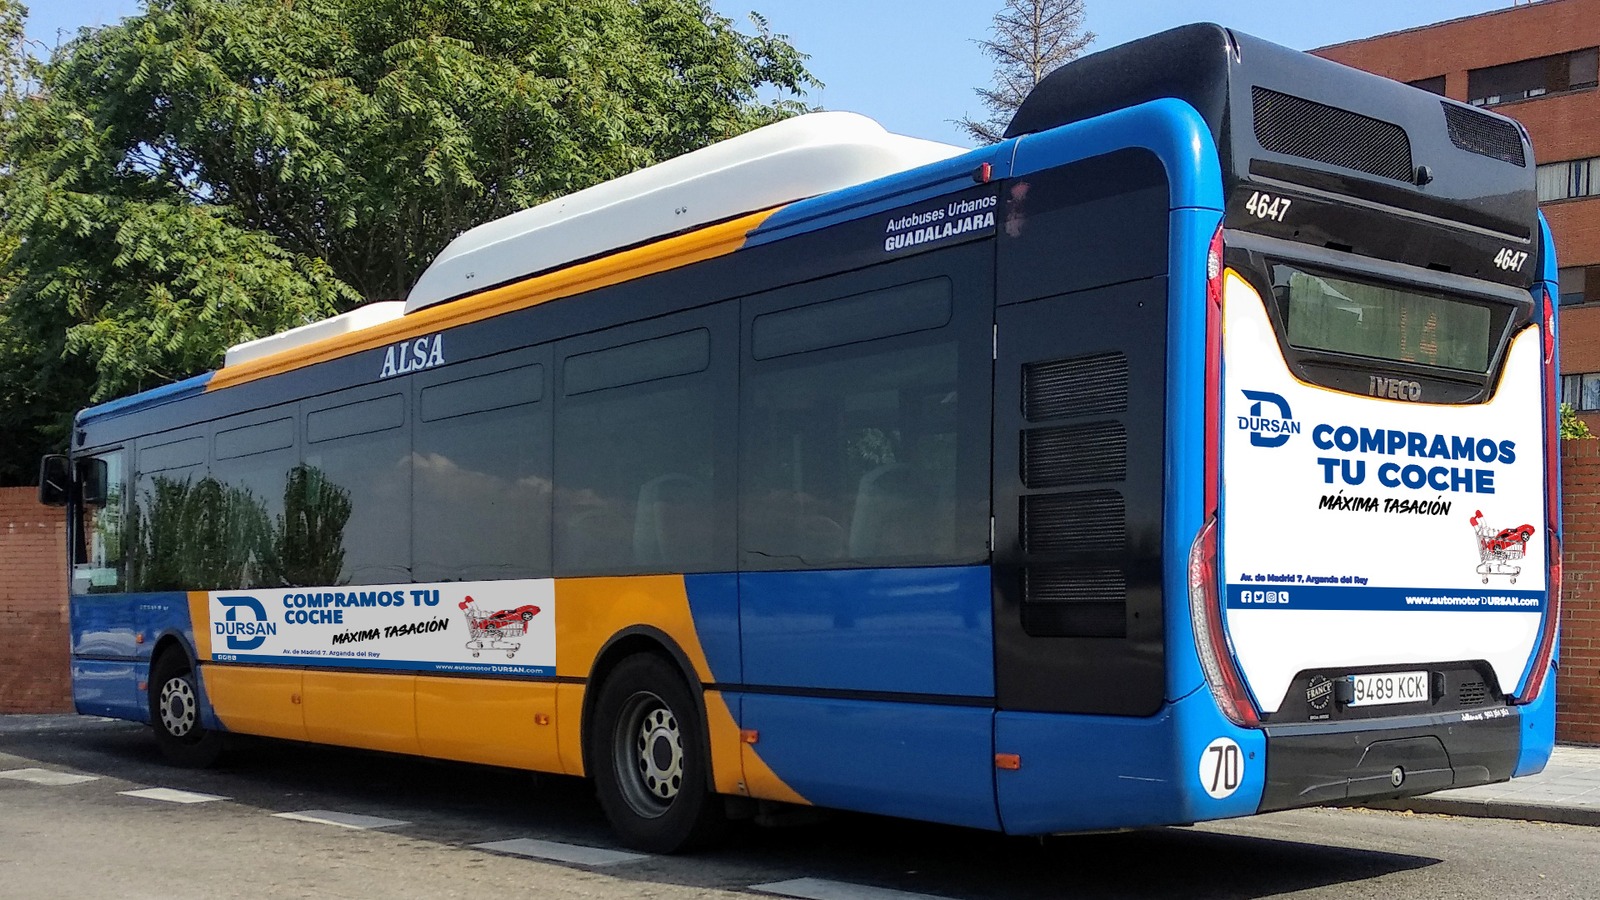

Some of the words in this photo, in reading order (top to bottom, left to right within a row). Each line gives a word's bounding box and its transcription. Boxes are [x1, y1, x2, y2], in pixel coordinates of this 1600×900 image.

[886, 209, 945, 233] Autobuses
[948, 195, 997, 217] Urbanos
[1245, 191, 1291, 222] 4647
[885, 211, 995, 252] GUADALAJARA
[1494, 247, 1528, 273] 4647
[380, 334, 445, 378] ALSA
[1369, 376, 1422, 401] IVECO
[1237, 416, 1301, 435] DURSAN
[1312, 423, 1516, 465] COMPRAMOS
[1317, 457, 1366, 486] TU
[1377, 462, 1495, 494] COCHE
[1319, 490, 1379, 513] MÁXIMA
[1384, 496, 1452, 516] TASACIÓN
[1255, 573, 1266, 582] de
[1267, 574, 1296, 583] Madrid
[1305, 575, 1339, 584] Arganda
[1340, 575, 1352, 584] del
[1353, 576, 1368, 585] Rey
[283, 591, 405, 608] COMPRAMOS
[409, 590, 440, 607] TU
[214, 621, 276, 636] DURSAN
[284, 609, 344, 625] COCHE
[332, 629, 381, 645] MÁXIMA
[384, 616, 449, 640] TASACIÓN
[1306, 682, 1332, 700] FRANCE
[1356, 677, 1394, 701] 9489
[1398, 675, 1424, 698] KCK
[1208, 745, 1238, 792] 70
